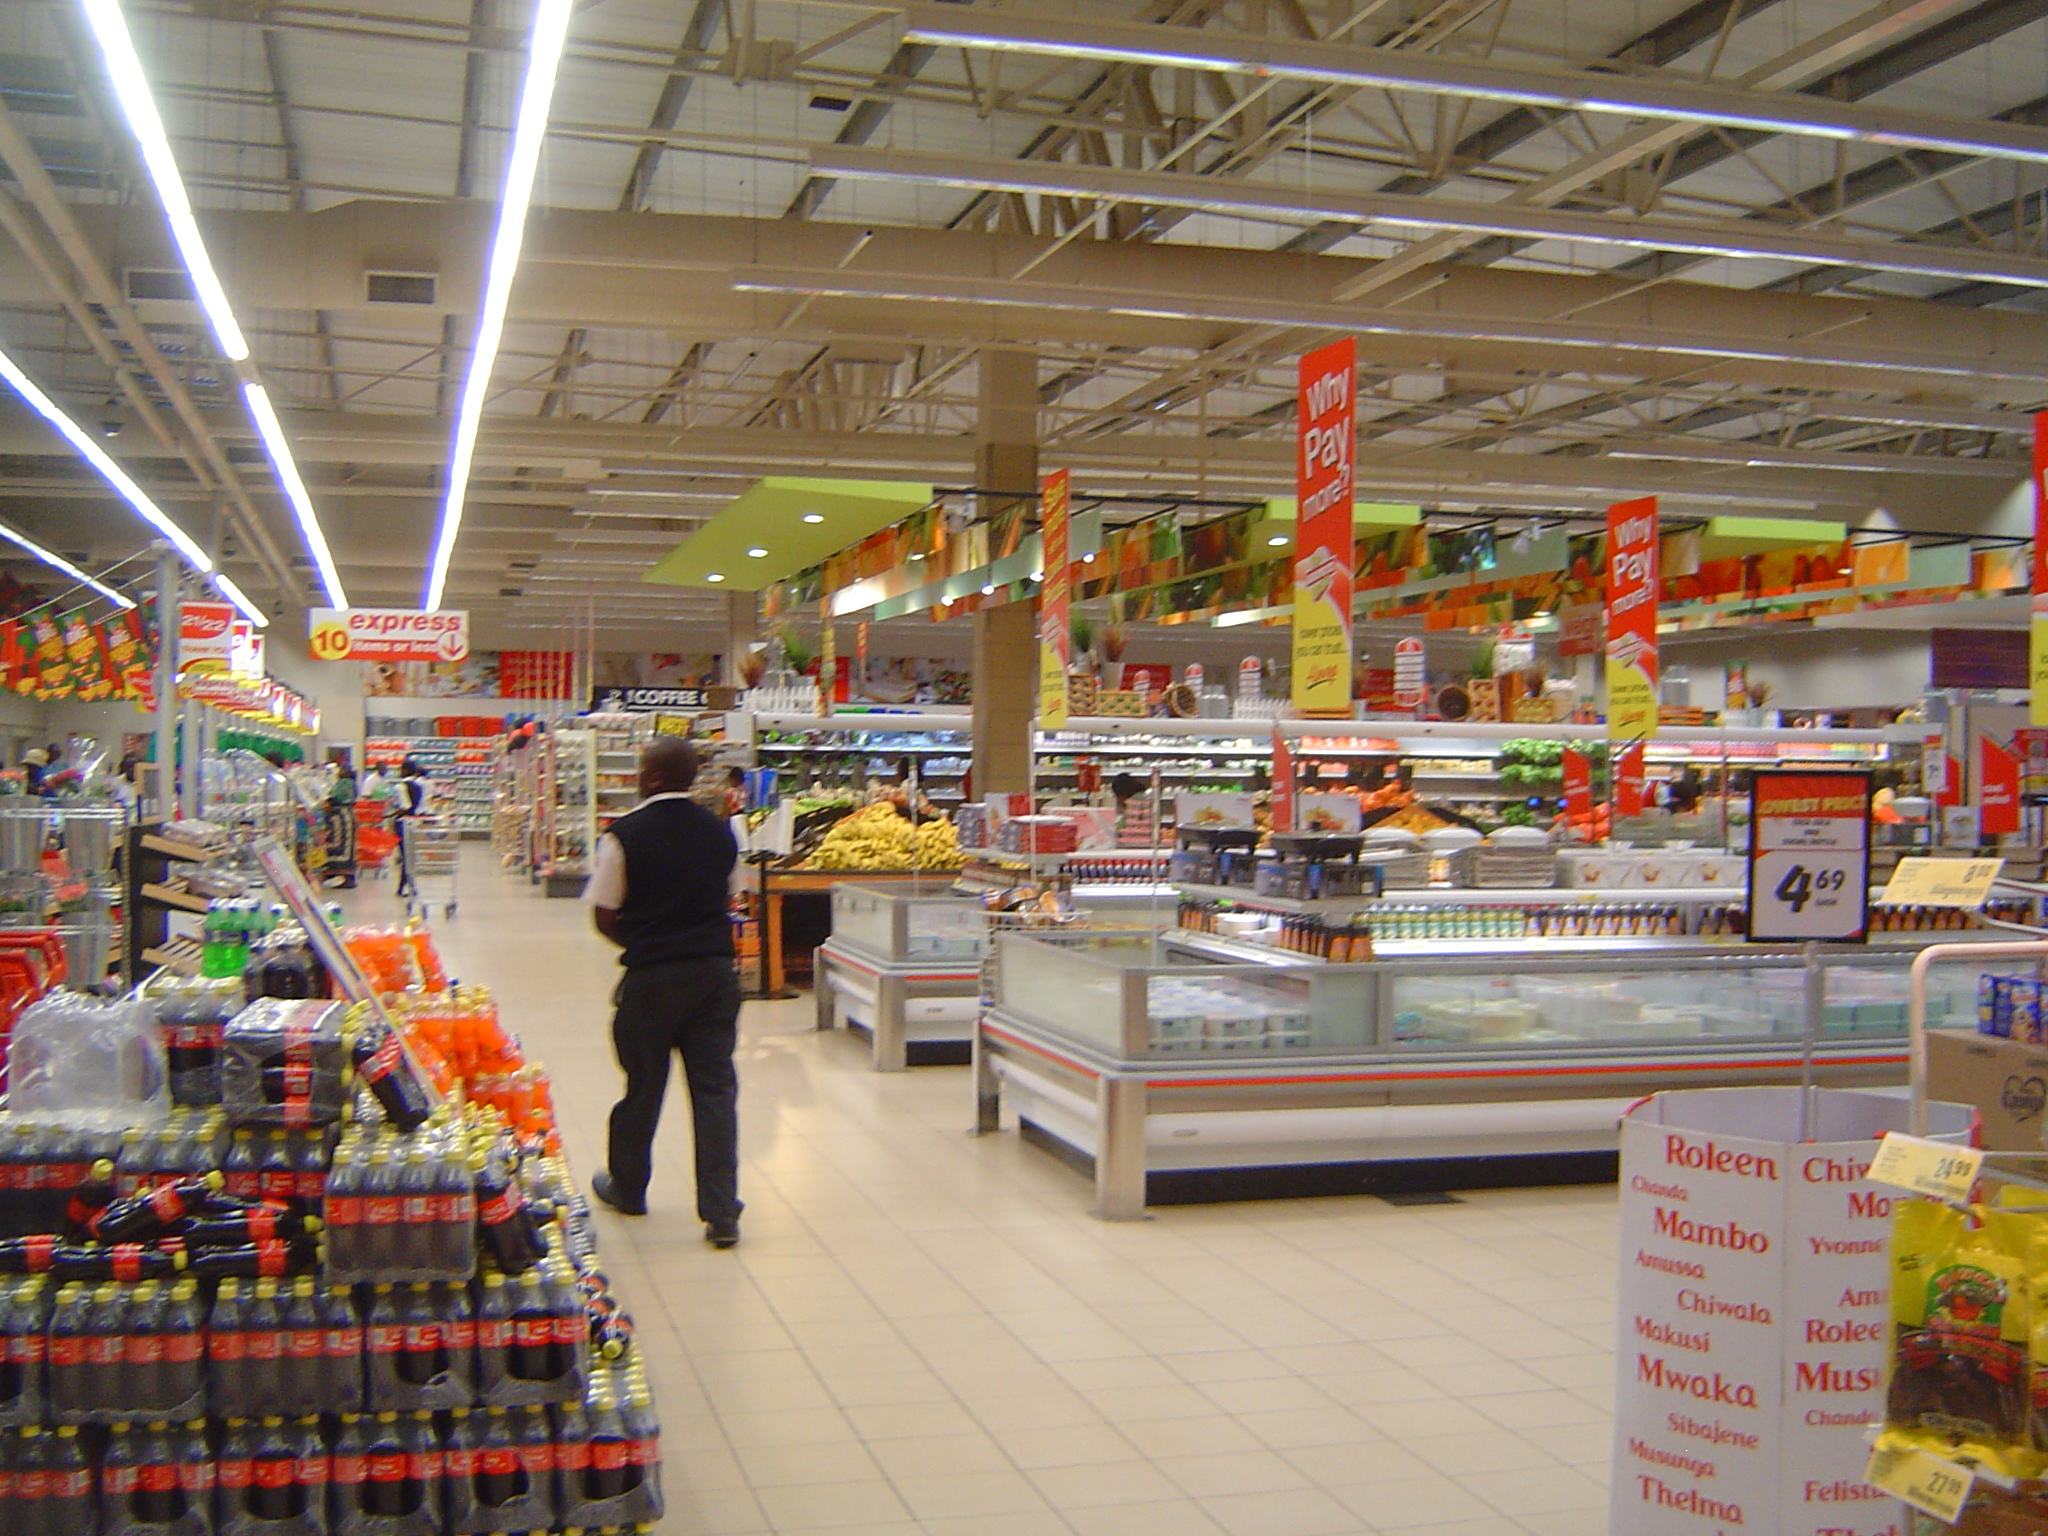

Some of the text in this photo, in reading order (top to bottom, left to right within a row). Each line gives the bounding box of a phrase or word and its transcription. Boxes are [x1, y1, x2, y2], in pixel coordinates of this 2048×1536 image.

[1305, 366, 1350, 422] Why
[1304, 415, 1350, 480] Pay
[1613, 514, 1653, 549] Why
[1612, 547, 1653, 587] Pay
[316, 630, 348, 651] 10
[349, 613, 460, 634] express
[634, 689, 700, 705] COFFEE
[1665, 1133, 1779, 1181] Roleen
[1803, 1156, 1872, 1183] Chiw
[1653, 1205, 1769, 1254] Mambo
[1677, 1288, 1773, 1325] Chiwala
[1838, 1287, 1881, 1307] Am
[1634, 1314, 1711, 1353] Makusi
[1805, 1319, 1882, 1343] Rolee
[1636, 1352, 1759, 1409] Mwaka
[1637, 1474, 1744, 1525] Thelma
